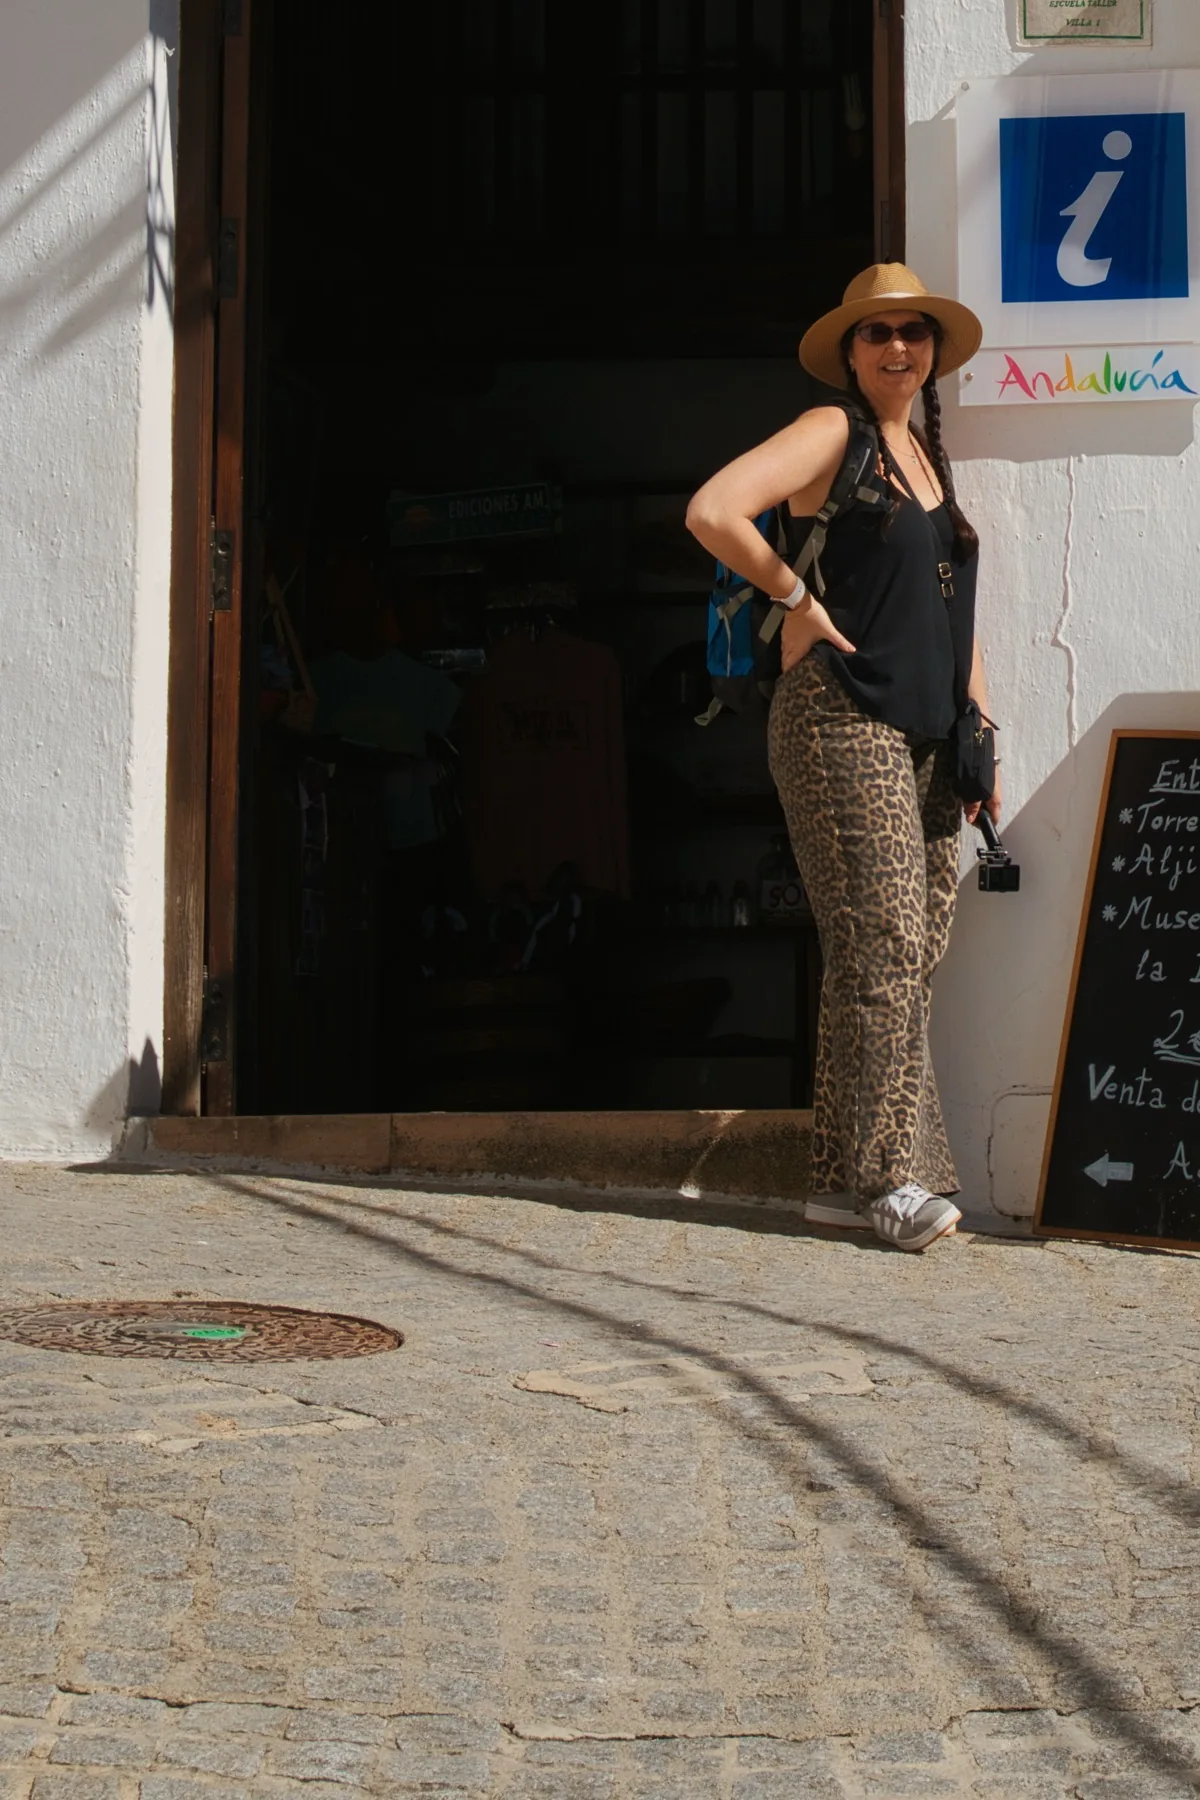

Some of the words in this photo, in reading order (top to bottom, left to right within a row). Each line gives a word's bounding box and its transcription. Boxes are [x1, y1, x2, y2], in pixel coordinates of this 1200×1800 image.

[1066, 18, 1091, 26] VILLA
[995, 350, 1199, 400] Andalucía
[448, 493, 519, 519] EDICIONES
[1135, 949, 1167, 981] la
[1088, 1063, 1166, 1109] Venta
